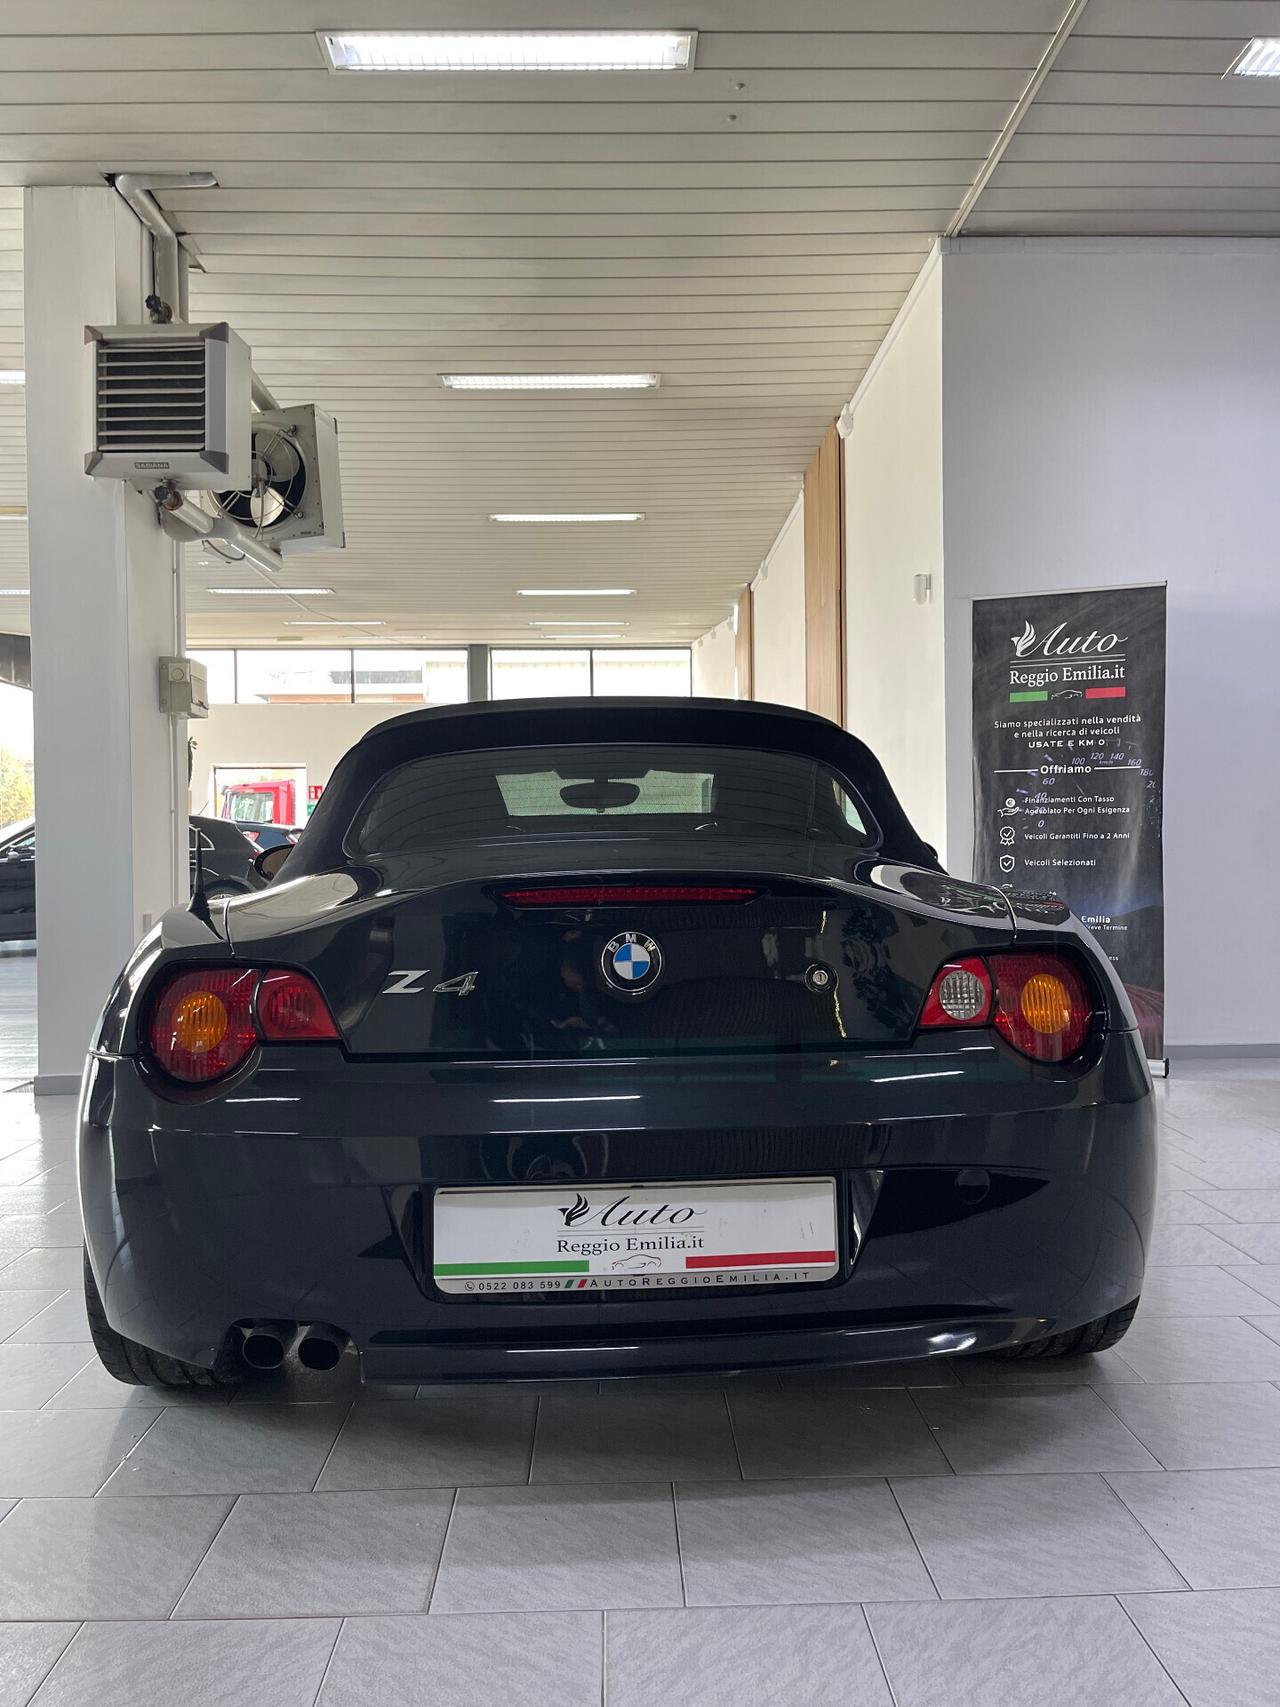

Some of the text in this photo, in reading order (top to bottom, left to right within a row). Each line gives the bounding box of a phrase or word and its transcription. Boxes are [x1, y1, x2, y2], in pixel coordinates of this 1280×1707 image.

[1022, 622, 1129, 657] Auto
[1009, 665, 1126, 687] Reggio Emilia.it
[994, 720, 1021, 729] Siamo
[1023, 716, 1079, 730] specializzati
[1081, 716, 1104, 725] nella
[1021, 728, 1043, 738] nella
[1045, 727, 1076, 737] ricerca
[1079, 727, 1088, 736] di
[1090, 726, 1120, 736] veicoli
[1028, 740, 1064, 748] USATE
[1067, 740, 1075, 748] E
[1078, 739, 1095, 747] KM
[1071, 757, 1086, 765] 100
[1090, 752, 1125, 760] 120 140
[1127, 758, 1142, 766] 160
[1040, 765, 1092, 775] Offriamo
[1042, 777, 1056, 785] 60
[1077, 807, 1095, 816] Ogni
[1097, 806, 1130, 815] Esigenza
[1024, 832, 1048, 840] Veicoli
[1050, 832, 1081, 840] Garantiti
[1083, 832, 1098, 840] Fino
[1106, 832, 1111, 840] 2
[1052, 858, 1096, 866] Selezionati
[1081, 915, 1111, 924] Emilia
[608, 933, 656, 952] BMW
[575, 1195, 707, 1227] Auto
[556, 1236, 705, 1256] Reggio Emilia.it
[478, 1281, 508, 1291] 0522
[513, 1281, 534, 1290] 083
[540, 1280, 561, 1289] 599
